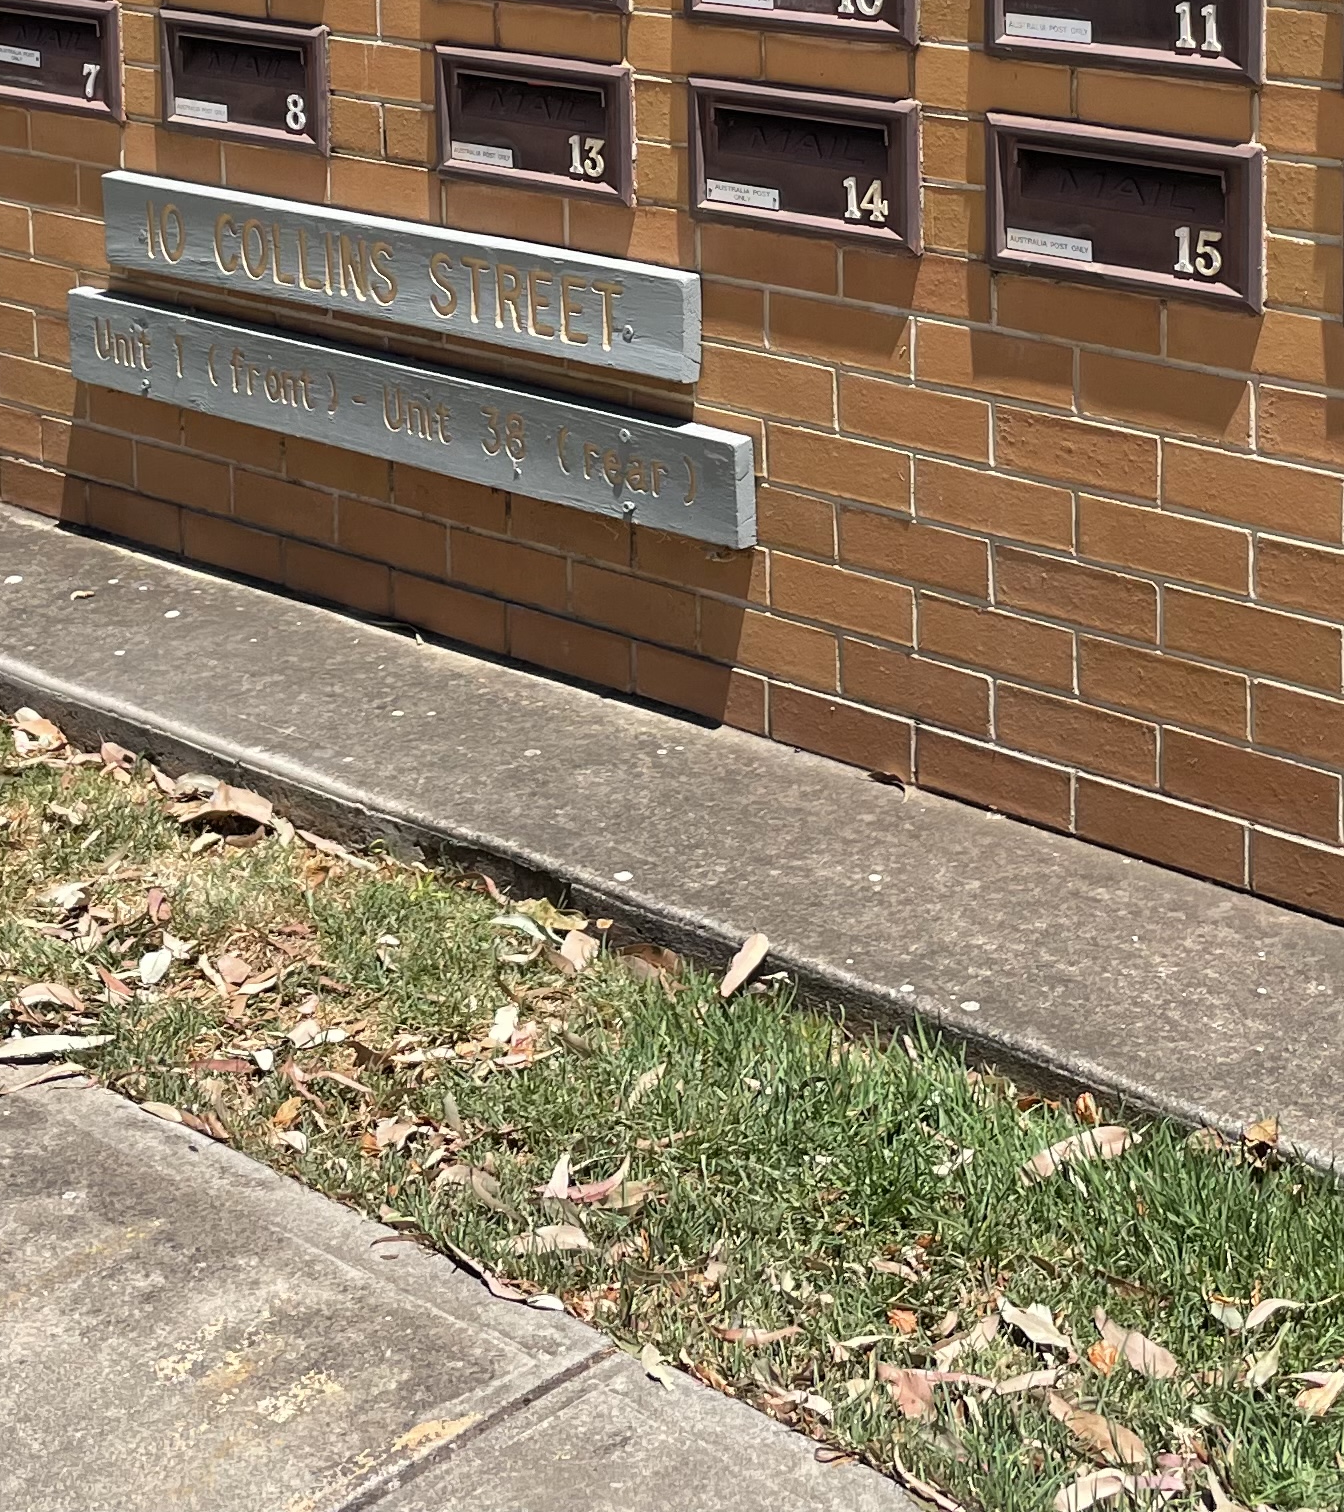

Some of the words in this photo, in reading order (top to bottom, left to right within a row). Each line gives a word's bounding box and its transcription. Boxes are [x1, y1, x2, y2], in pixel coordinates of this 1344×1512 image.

[1008, 21, 1045, 31] AUSTRALIA
[1049, 25, 1066, 33] POST
[1070, 27, 1088, 36] ONLY
[1173, 1, 1222, 53] 11
[82, 63, 100, 98] 7
[285, 94, 306, 130] 8
[568, 134, 605, 177] 13
[714, 184, 749, 194] AUSTRALIA
[842, 176, 889, 222] 14
[1009, 235, 1047, 247] AUSTRALIA
[1050, 241, 1068, 250] POST
[1071, 245, 1088, 254] ONLY
[1173, 226, 1223, 277] 15
[144, 199, 186, 265] 10
[213, 212, 398, 307] COLLINS
[427, 251, 624, 352] STREET
[92, 316, 151, 371] Unit
[173, 334, 185, 379] 1
[207, 344, 338, 416] (front)
[382, 384, 454, 447] Unit
[480, 405, 527, 464] 38
[554, 425, 699, 507] (rear)
